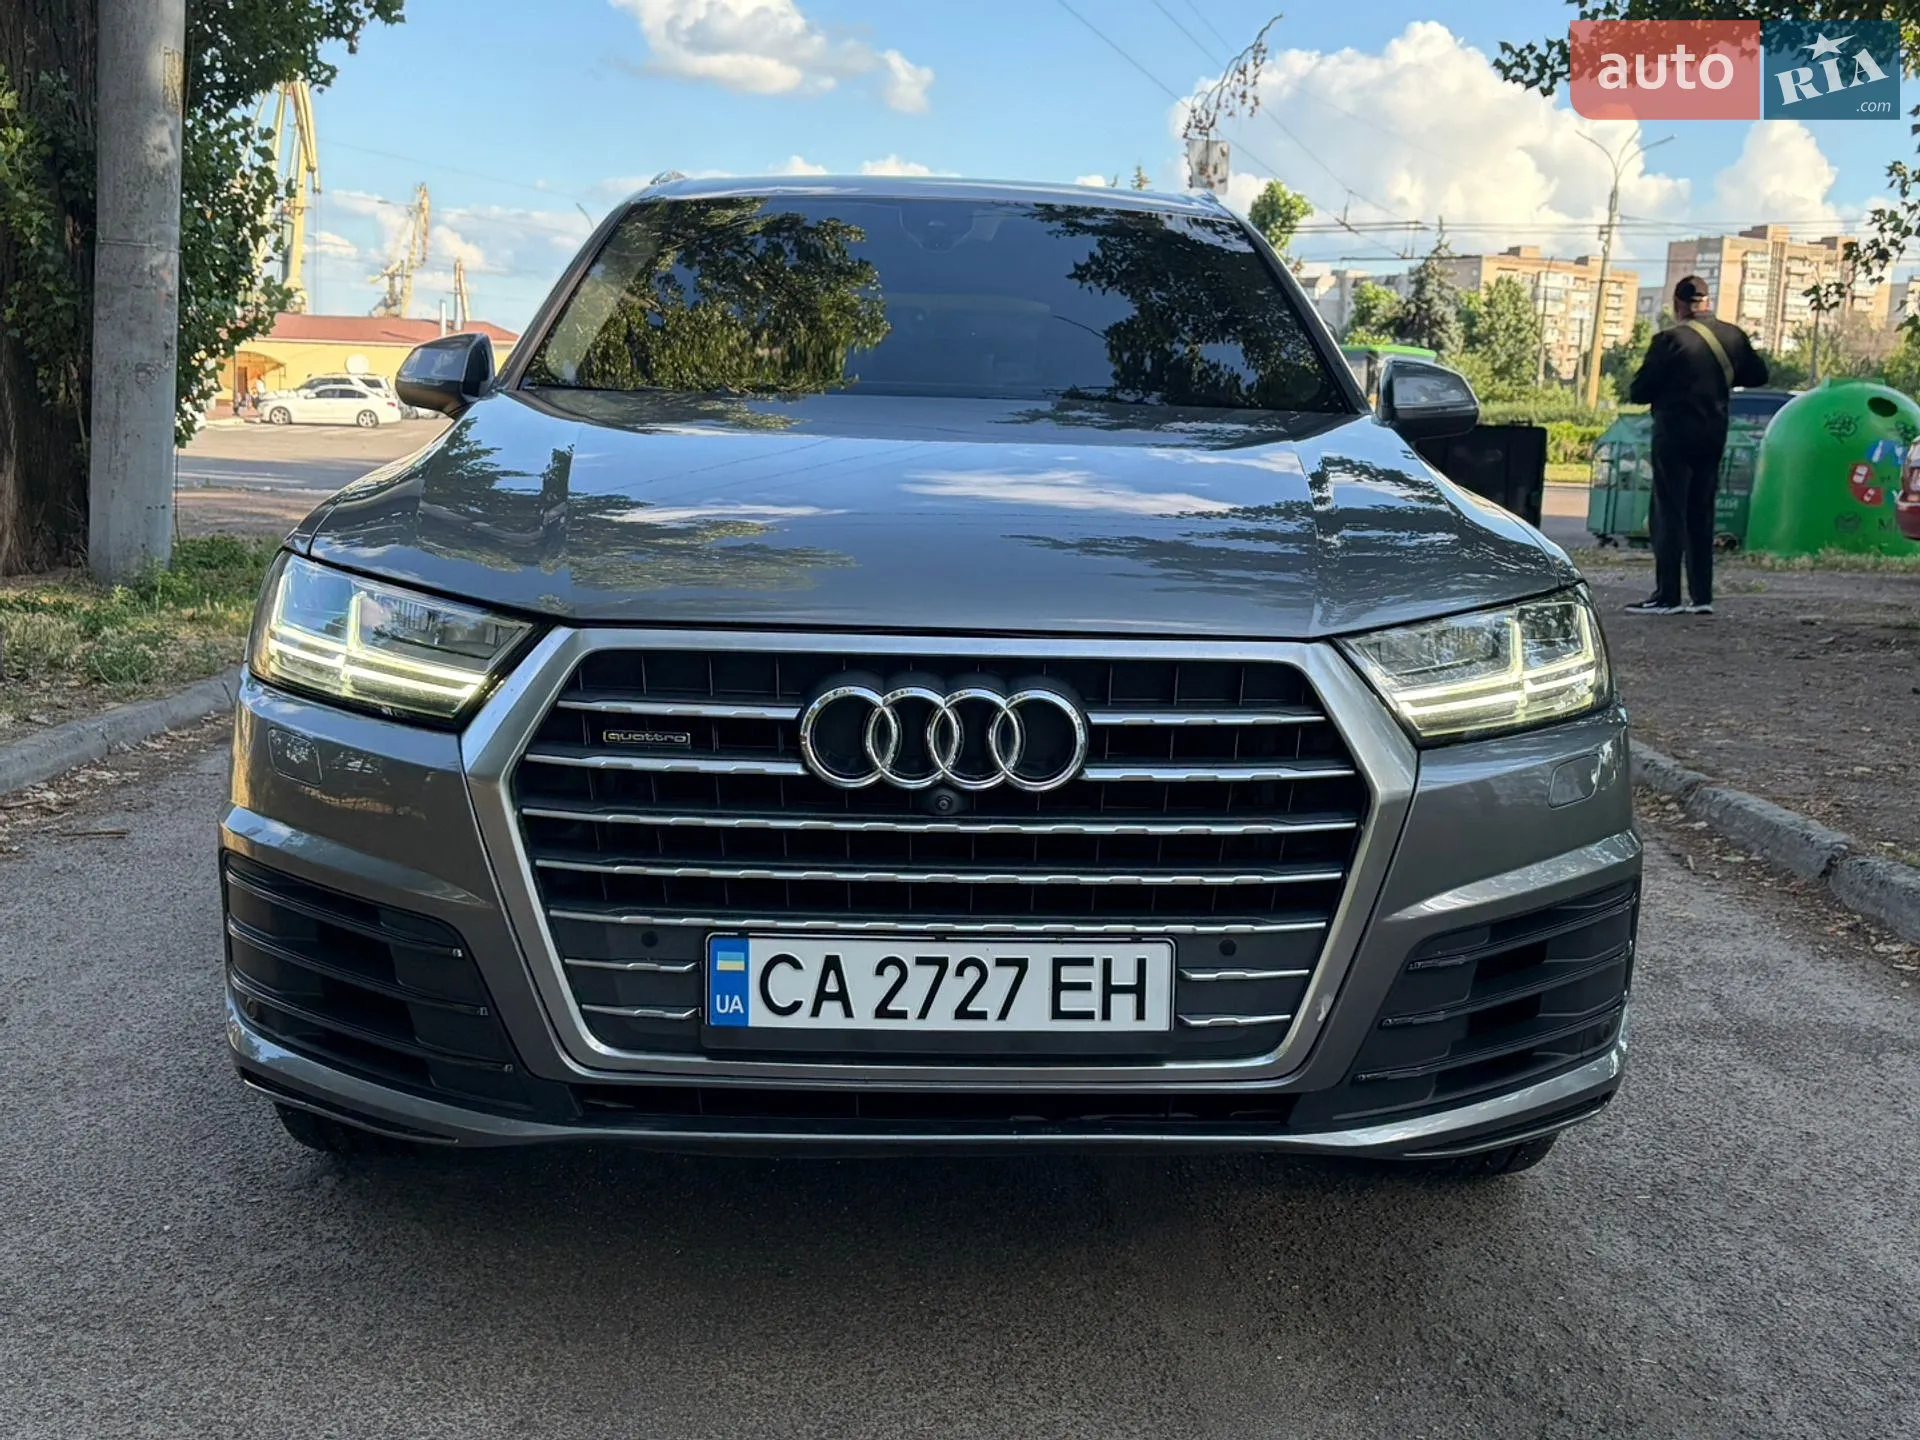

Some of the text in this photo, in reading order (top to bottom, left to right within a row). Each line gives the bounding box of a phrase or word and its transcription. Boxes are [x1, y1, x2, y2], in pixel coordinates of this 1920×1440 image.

[607, 732, 687, 743] quattro
[759, 953, 1147, 1021] CA 2727 EH
[716, 994, 744, 1014] UA
